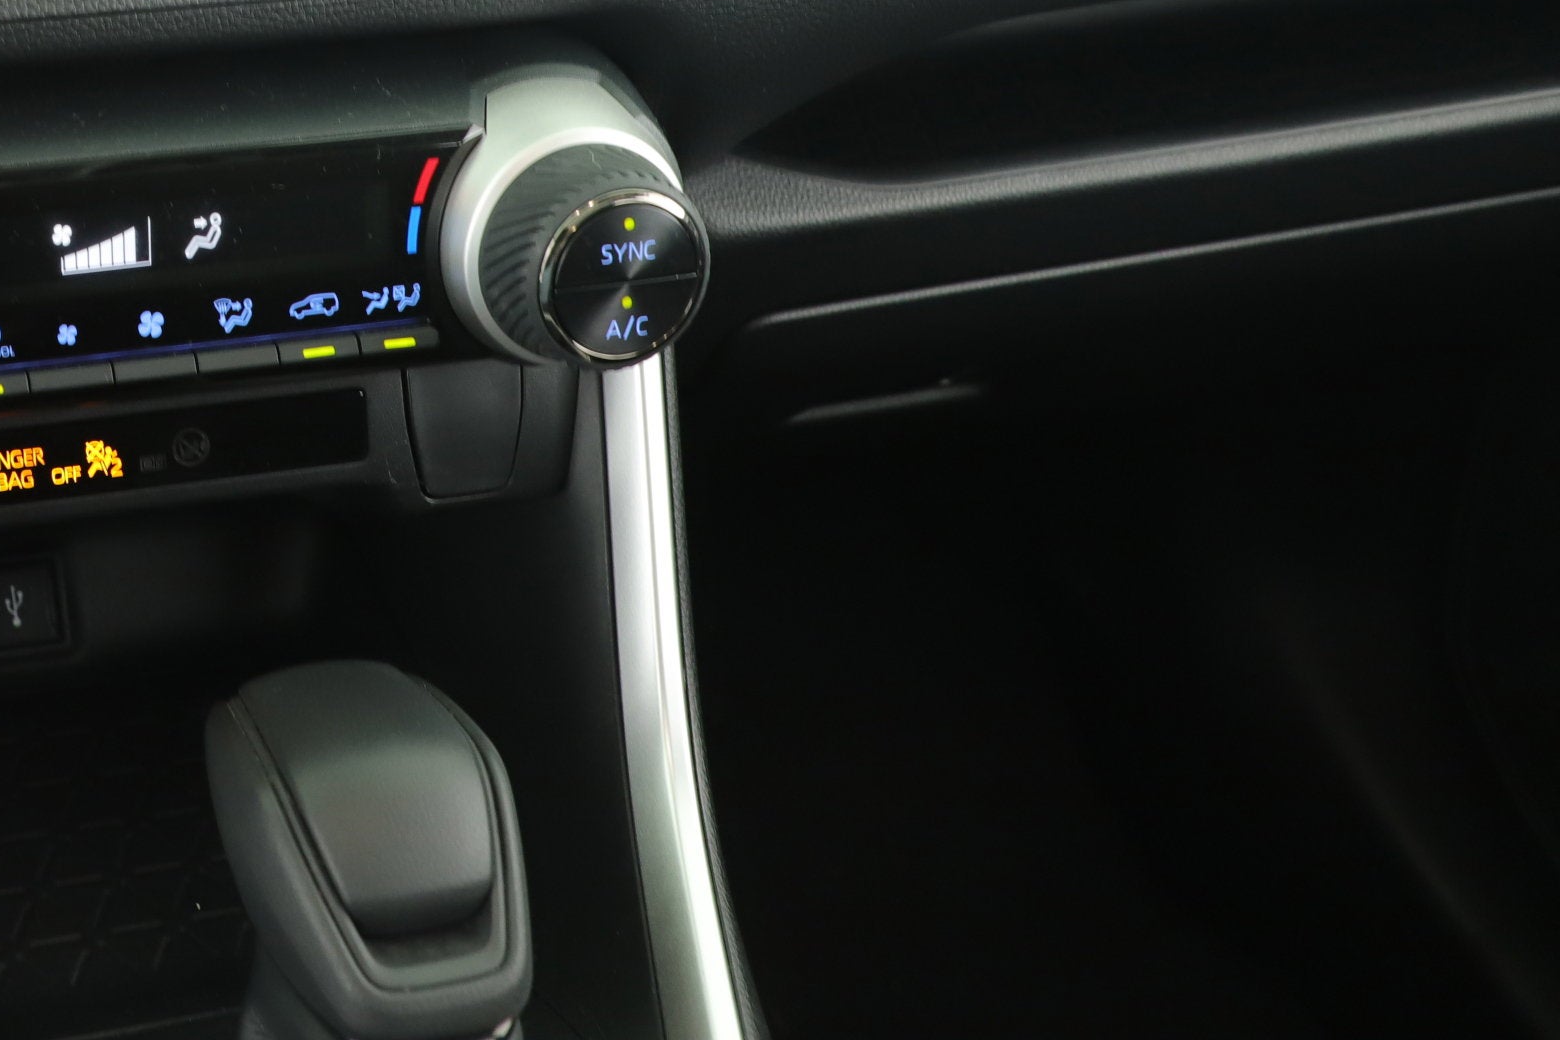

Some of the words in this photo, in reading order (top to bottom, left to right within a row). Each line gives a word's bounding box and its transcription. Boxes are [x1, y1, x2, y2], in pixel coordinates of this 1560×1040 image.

[601, 239, 657, 266] SYNC
[605, 315, 649, 341] A/C
[51, 464, 82, 486] OFF
